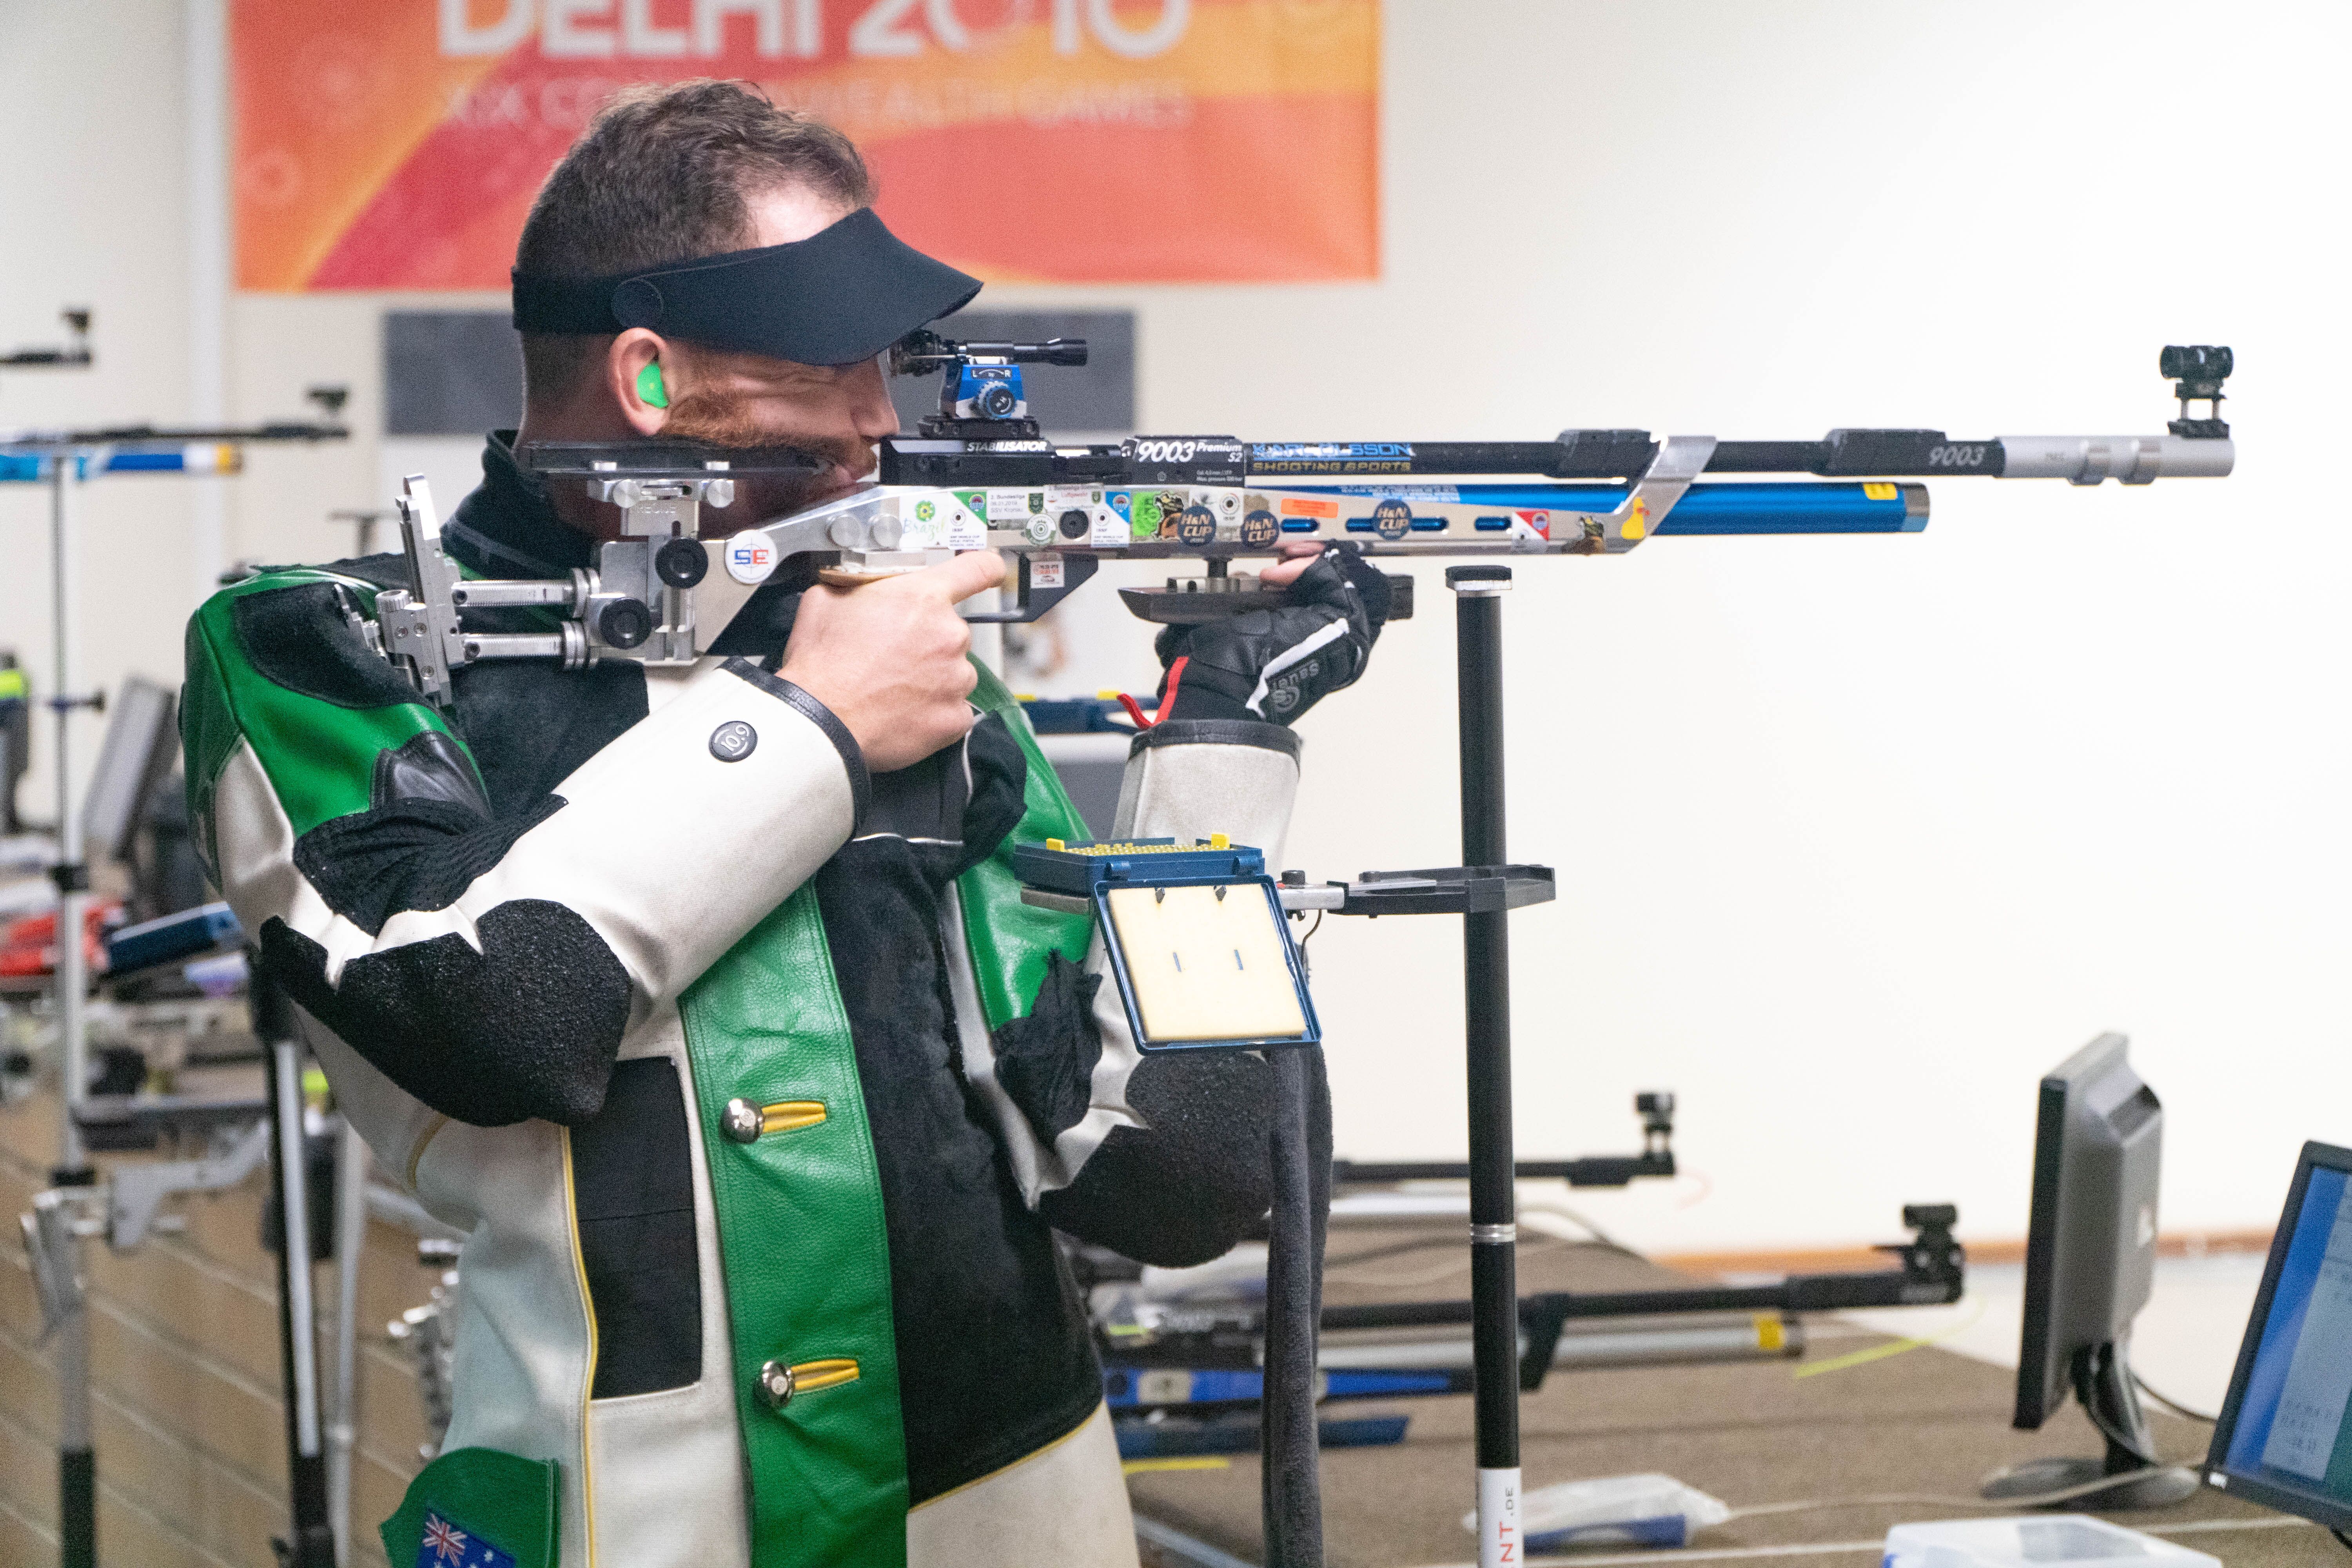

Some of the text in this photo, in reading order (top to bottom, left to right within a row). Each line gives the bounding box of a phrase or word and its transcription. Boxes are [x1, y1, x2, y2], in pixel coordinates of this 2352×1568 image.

[438, 0, 820, 56] DELHI
[1004, 369, 1011, 377] R
[967, 440, 1047, 452] STABILISATOR
[1138, 441, 1243, 463] 9003 Premium
[1227, 452, 1243, 463] S2
[1929, 445, 1986, 466] 9003
[1254, 461, 1411, 471] SHOOTING SPORTS
[1377, 507, 1407, 518] H&N
[1180, 514, 1211, 525] H&N
[1244, 518, 1273, 531] H&N
[1379, 518, 1409, 530] CUP
[1183, 526, 1213, 537] CUP
[1248, 528, 1276, 542] CUP
[734, 549, 769, 564] SE
[1499, 1487, 1514, 1568] NT.DE
